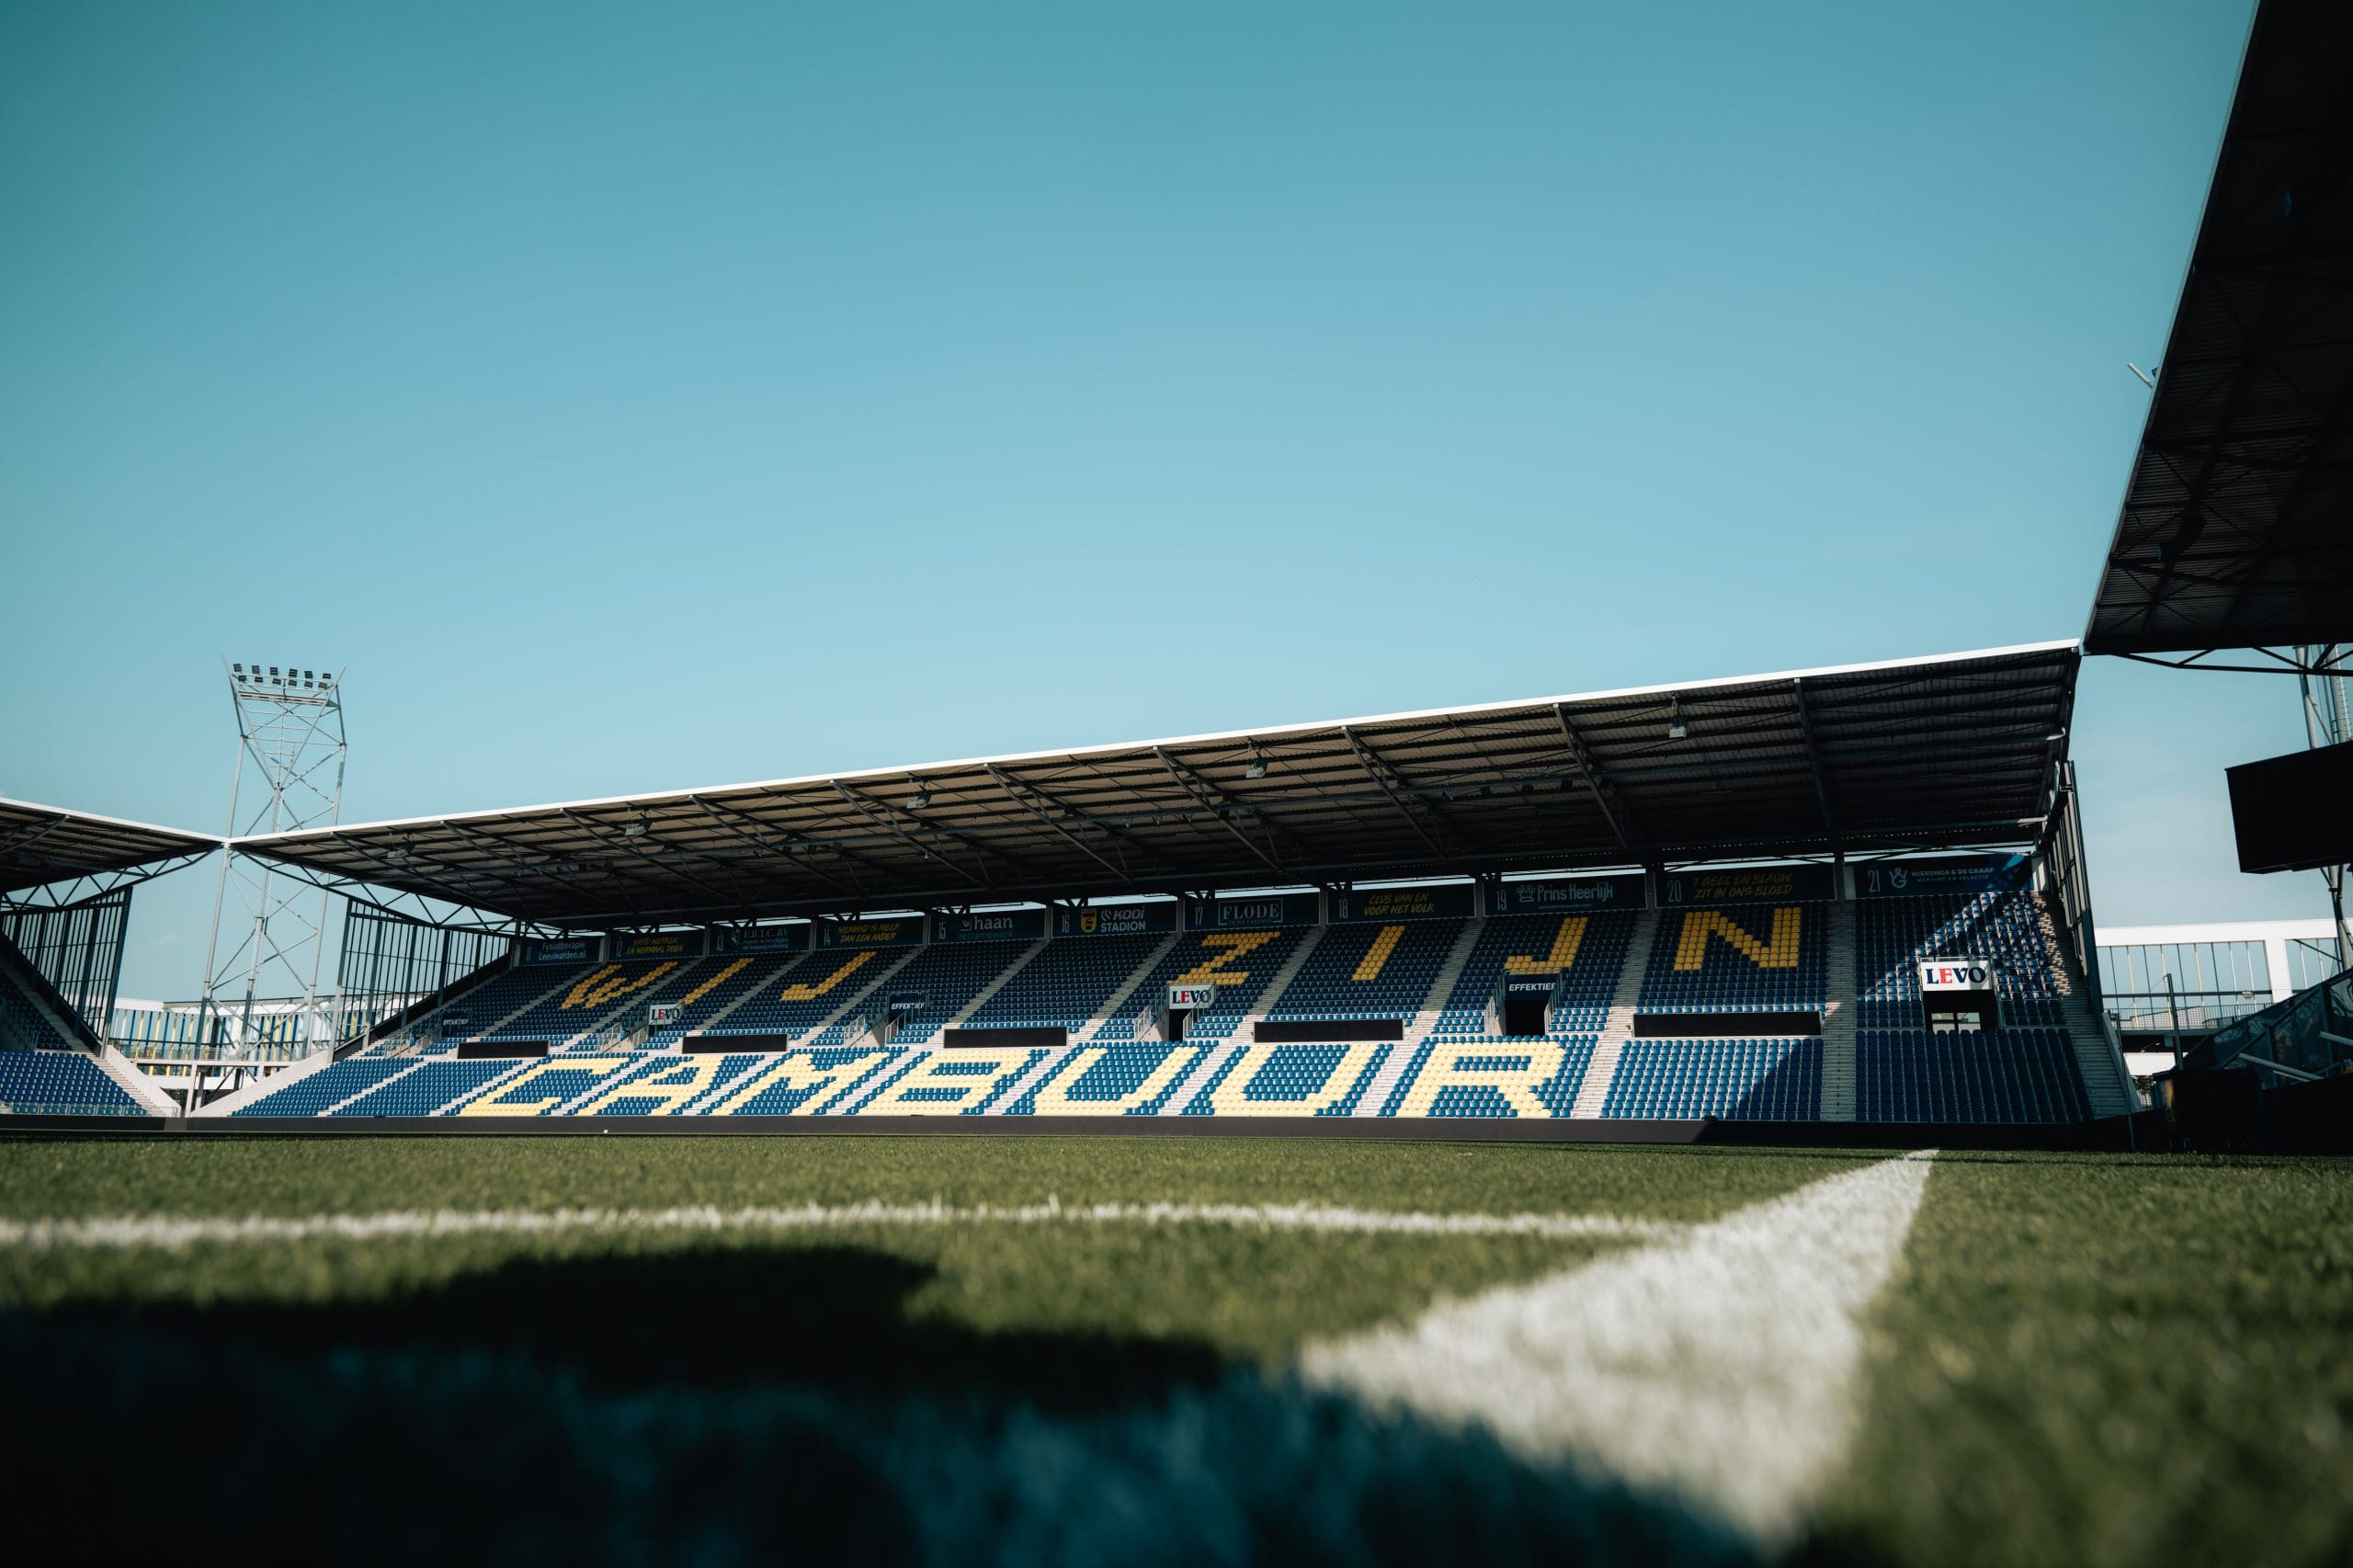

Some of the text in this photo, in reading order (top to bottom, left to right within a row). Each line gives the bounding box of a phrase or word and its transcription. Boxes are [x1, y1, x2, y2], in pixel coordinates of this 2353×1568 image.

[1701, 875, 1731, 887] GEEL
[1733, 874, 1751, 885] EN
[1752, 872, 1792, 884] BLAUW
[1868, 869, 1881, 892] 21
[1369, 892, 1429, 904] CLUB VAN EN
[1496, 889, 1506, 910] 19
[1537, 884, 1567, 902] Prins
[1666, 880, 1683, 903] 20
[1694, 883, 1793, 899] ZIT IN ONS BLOED
[1195, 905, 1203, 926] 17
[1222, 903, 1280, 920] FLODE
[1338, 898, 1348, 919] 18
[1363, 902, 1435, 915] VOOR HET VOLK
[938, 920, 946, 940] 15
[973, 915, 1014, 930] haan
[1062, 913, 1070, 933] 16
[1100, 921, 1146, 933] STADION
[824, 927, 831, 947] 14
[840, 934, 855, 943] DAN
[870, 932, 896, 941] ANDER
[537, 949, 586, 960] Leeuwarden.nl
[616, 940, 623, 957] 12
[559, 907, 1802, 1011] WIJ ZIJN
[1925, 967, 1986, 984] LEVO
[1508, 983, 1556, 992] EFFEKTIEF
[1172, 990, 1211, 1005] LEVO
[652, 1007, 681, 1020] LEVO
[460, 1041, 1561, 1119] CAMBUUR
